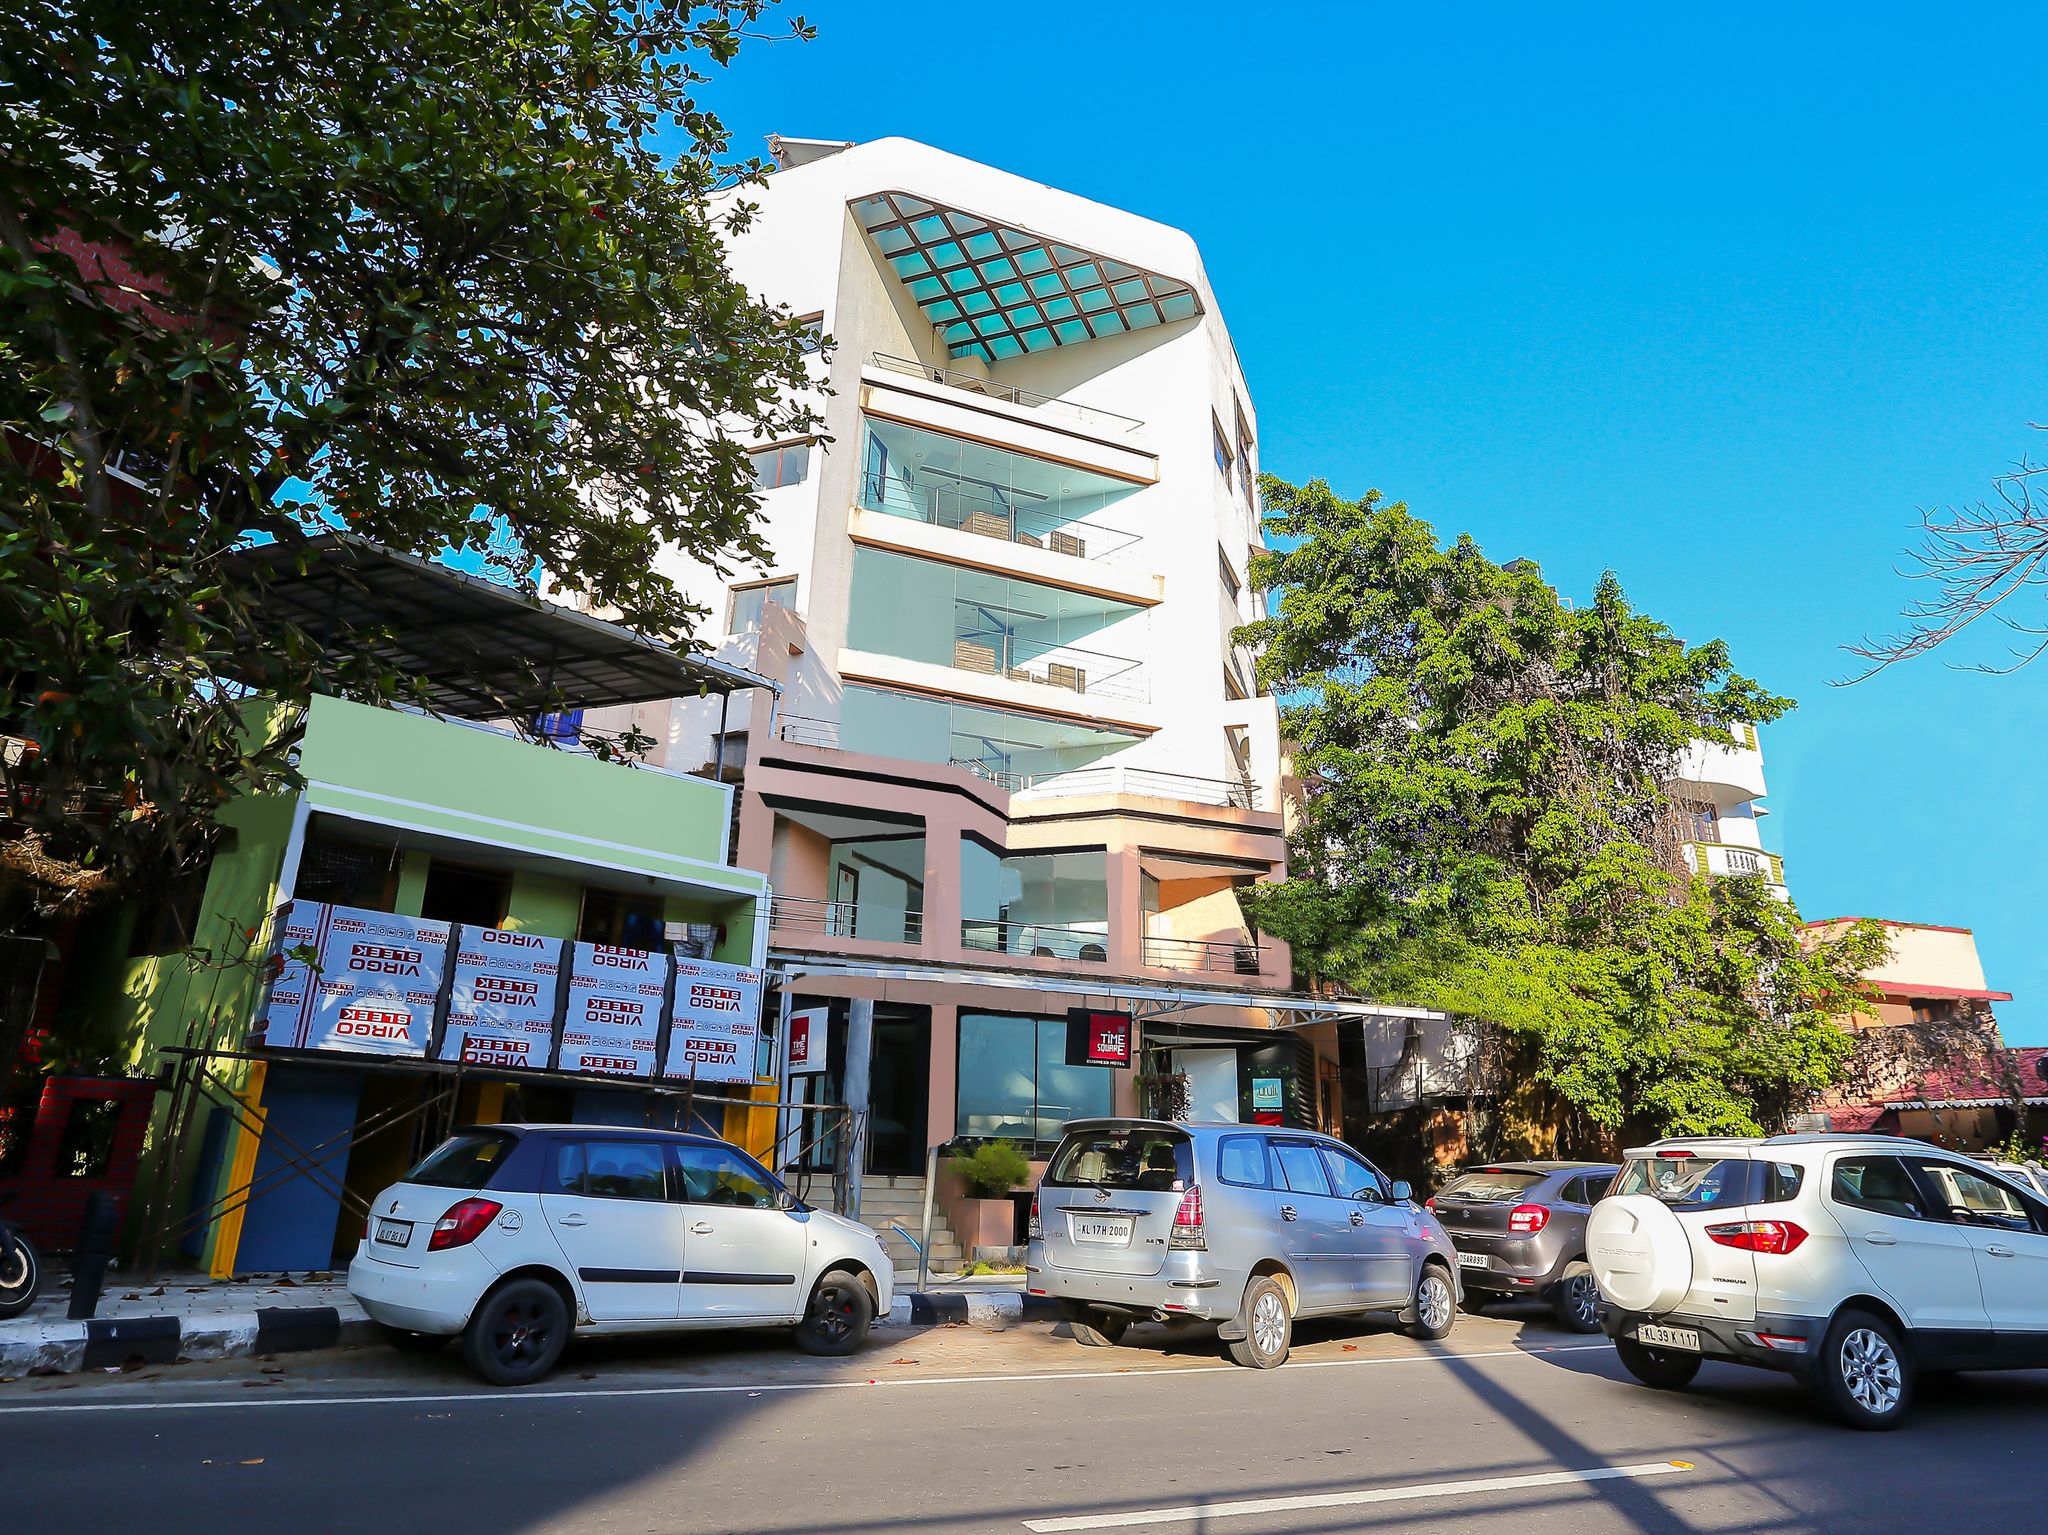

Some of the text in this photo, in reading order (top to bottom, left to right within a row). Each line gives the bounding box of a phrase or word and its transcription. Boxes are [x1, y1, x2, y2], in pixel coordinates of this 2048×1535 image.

[332, 924, 364, 934] VIRGO
[416, 935, 448, 945] VIRGO
[482, 930, 544, 950] VIRGO
[356, 946, 420, 962] SLEEK
[596, 944, 648, 958] SLEEK
[349, 958, 420, 978] VIRGO
[458, 958, 487, 967] VIRGO
[592, 954, 648, 972] VIRGO
[532, 968, 560, 976] VIRGO
[479, 978, 536, 993] SLEEK
[571, 980, 598, 989] VIRGO
[736, 976, 759, 984] VIRGO
[320, 988, 354, 998] VIRGO
[473, 990, 537, 1008] VIRGO
[638, 989, 663, 997] VIRGO
[692, 986, 740, 1000] SLEEK
[406, 997, 437, 1006] VIRGO
[591, 1000, 642, 1013] SLEEK
[690, 997, 740, 1012] VIRGO
[344, 1010, 410, 1024] SLEEK
[448, 1018, 478, 1027] VIRGO
[586, 1010, 642, 1026] VIRGO
[336, 1022, 410, 1040] VIRGO
[524, 1026, 552, 1034] VIRGO
[564, 1038, 590, 1046] VIRGO
[1100, 1030, 1126, 1044] TIME
[468, 1038, 528, 1052] SLEEK
[632, 1044, 656, 1052] VIRGO
[688, 1040, 735, 1052] SLEEK
[1097, 1044, 1126, 1056] SQUARE
[464, 1051, 528, 1068] VIRGO
[582, 1057, 636, 1070] SLEEK
[684, 1051, 736, 1065] VIRGO
[1082, 1224, 1128, 1237] KL 17H 2000
[1712, 1277, 1747, 1285] TITANIUM
[1644, 1328, 1697, 1346] KL 39 K 117
